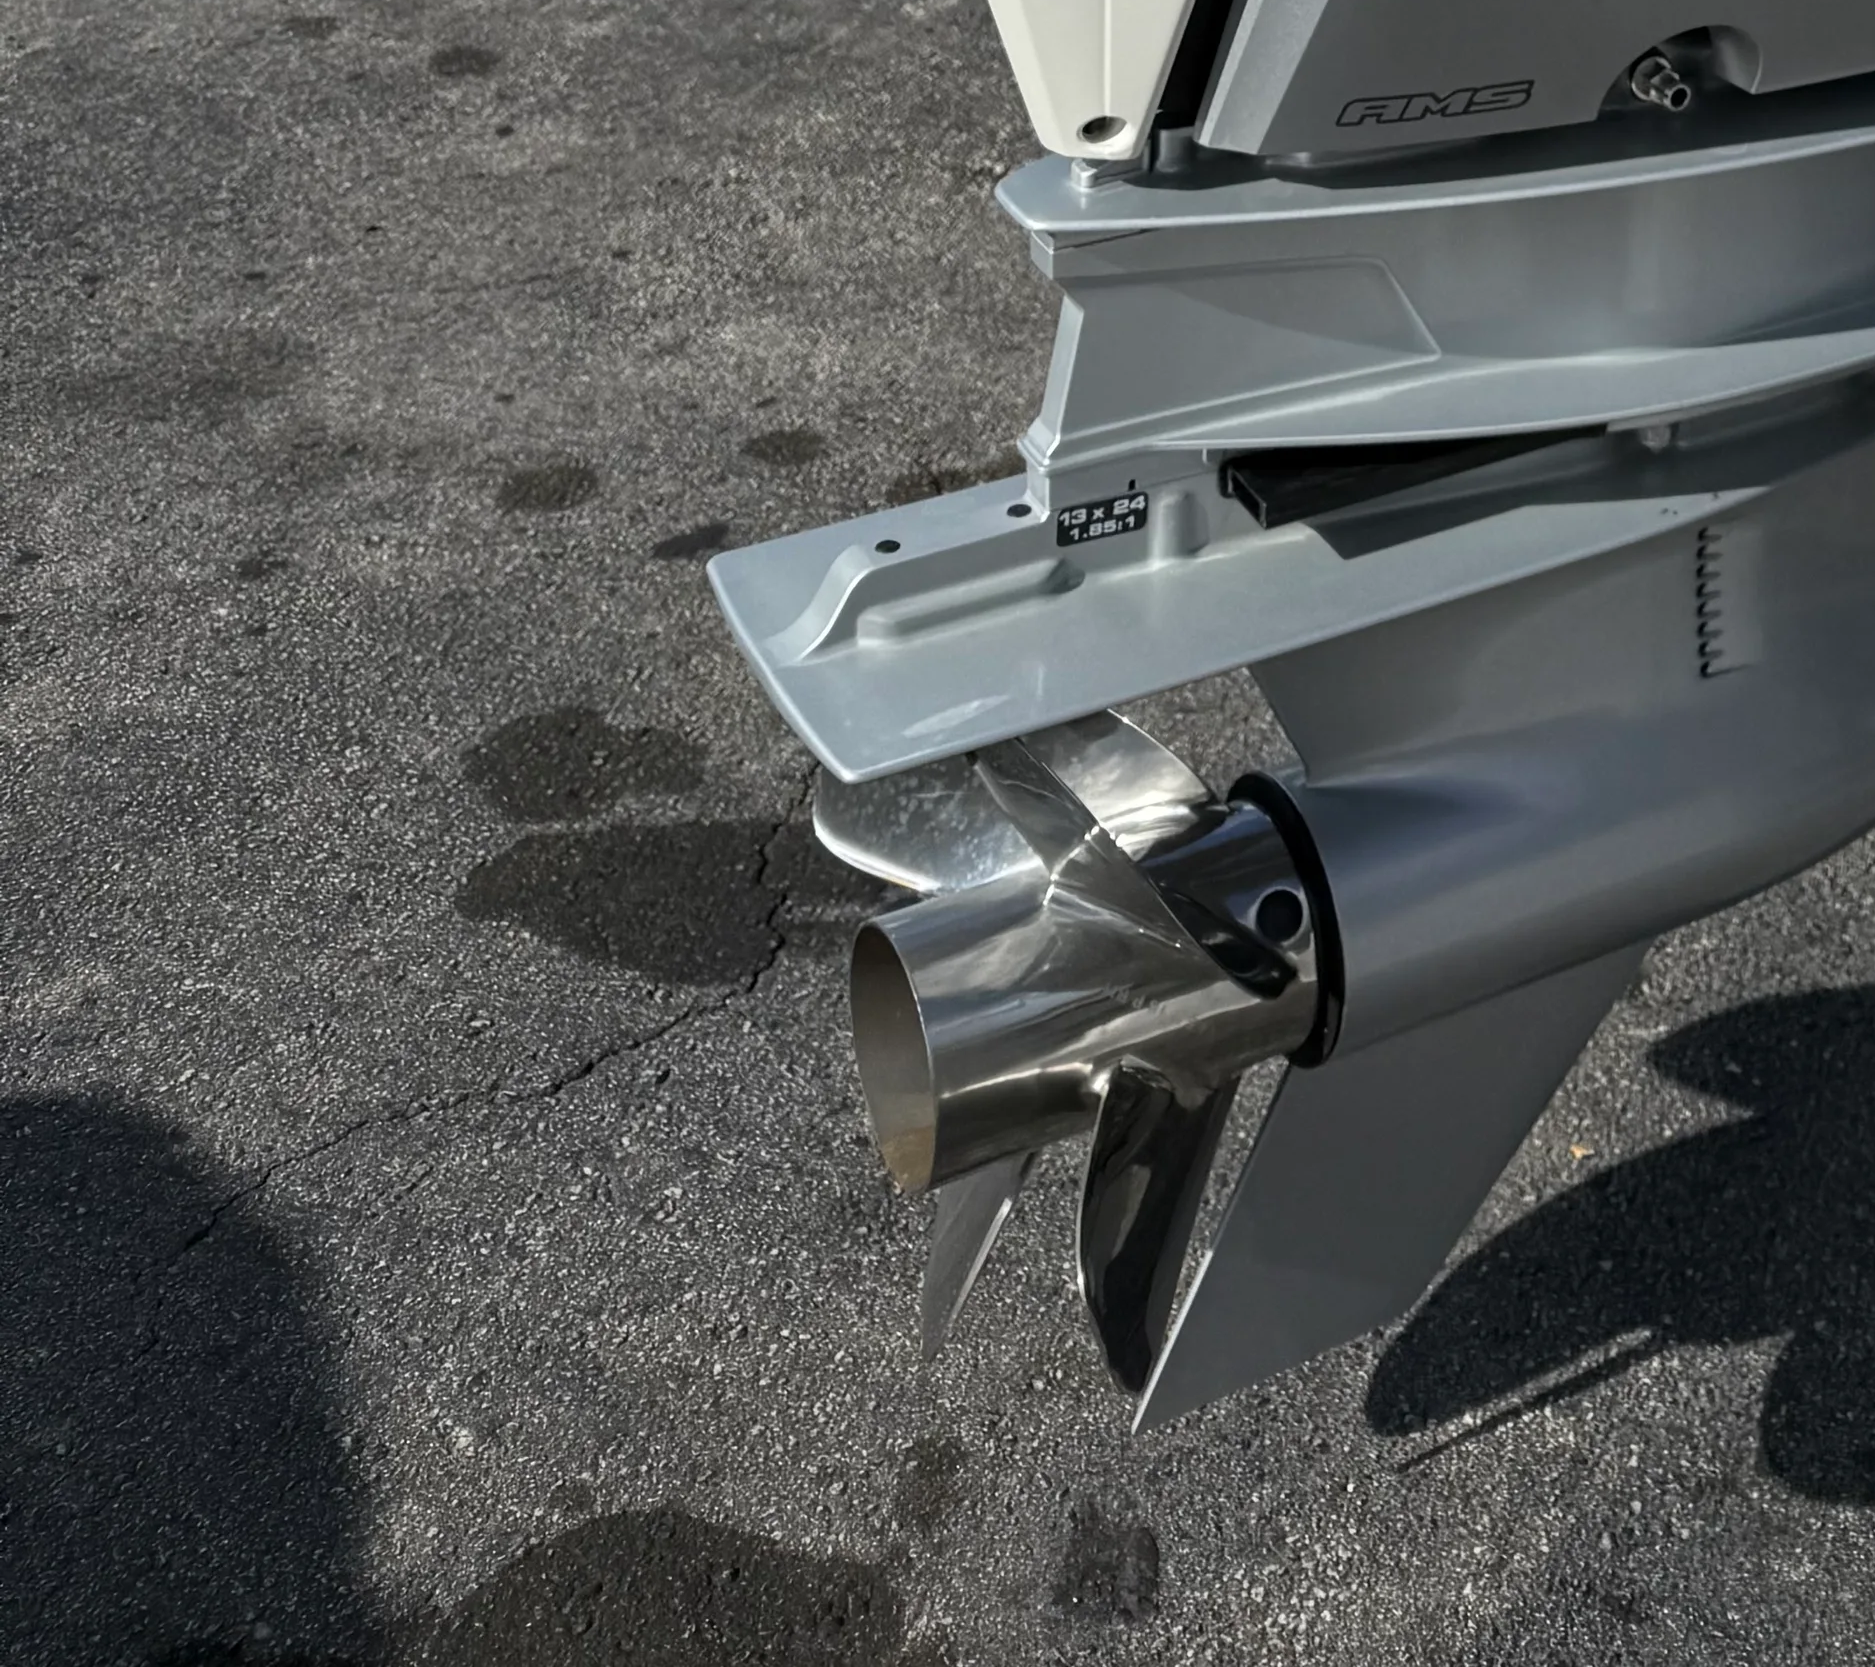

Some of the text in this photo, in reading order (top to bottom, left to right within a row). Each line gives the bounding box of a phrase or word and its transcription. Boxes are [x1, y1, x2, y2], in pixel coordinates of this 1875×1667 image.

[1335, 79, 1535, 127] AMS
[1059, 495, 1146, 526] 13 x 24
[1069, 514, 1135, 540] 1.85:1
